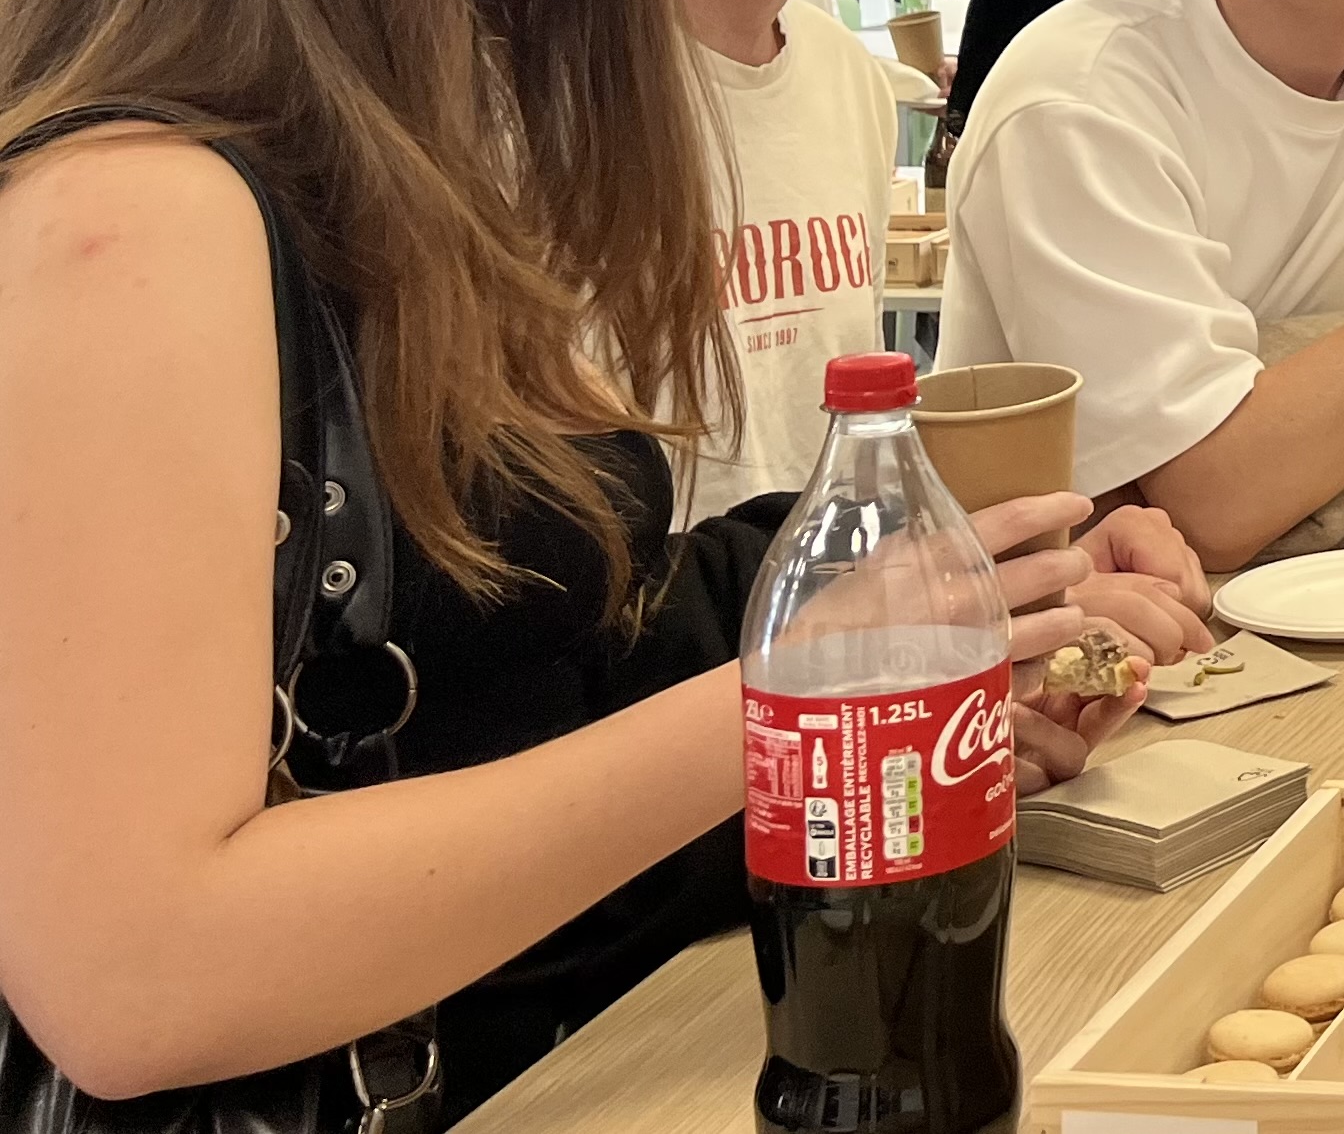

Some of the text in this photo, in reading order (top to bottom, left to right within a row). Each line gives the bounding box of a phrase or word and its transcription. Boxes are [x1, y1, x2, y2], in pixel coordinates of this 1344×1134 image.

[775, 327, 798, 347] 1997
[869, 700, 932, 726] 1.25L
[840, 703, 857, 881] EMBALLAGE ENTIÈREMENT
[859, 784, 873, 880] RECYCLABLE
